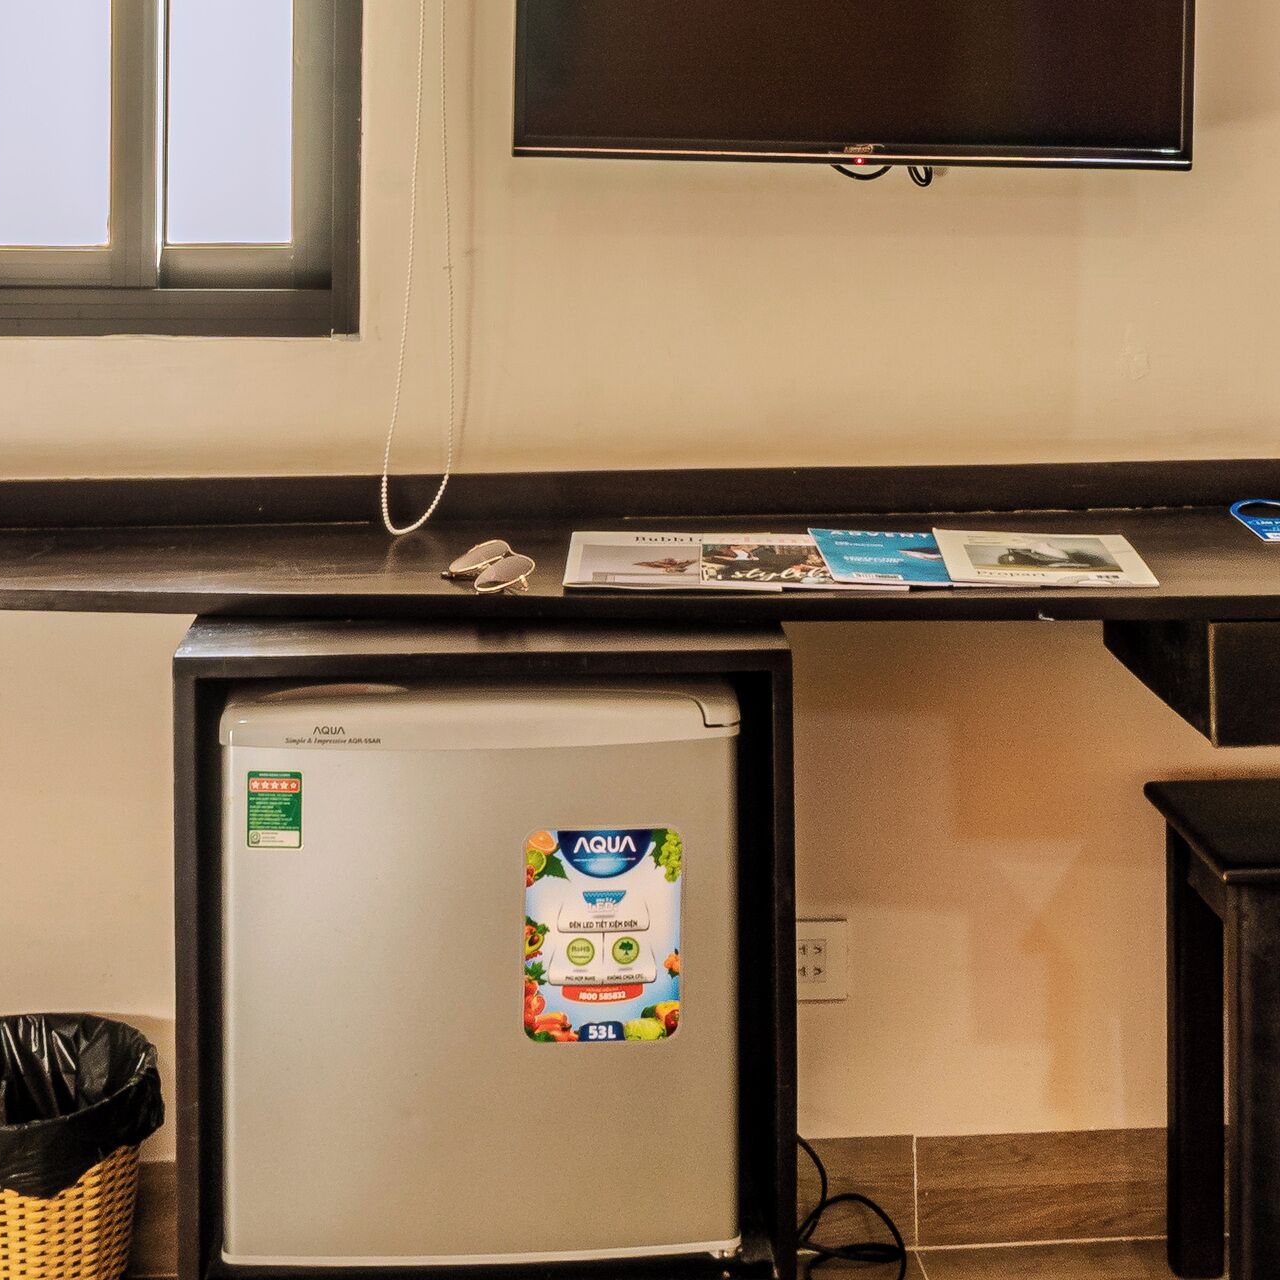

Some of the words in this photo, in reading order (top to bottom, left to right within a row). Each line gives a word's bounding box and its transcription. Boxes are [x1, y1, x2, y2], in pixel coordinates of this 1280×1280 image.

[312, 726, 345, 735] AQUA
[573, 835, 637, 854] AQUA
[588, 1025, 617, 1040] 53L
